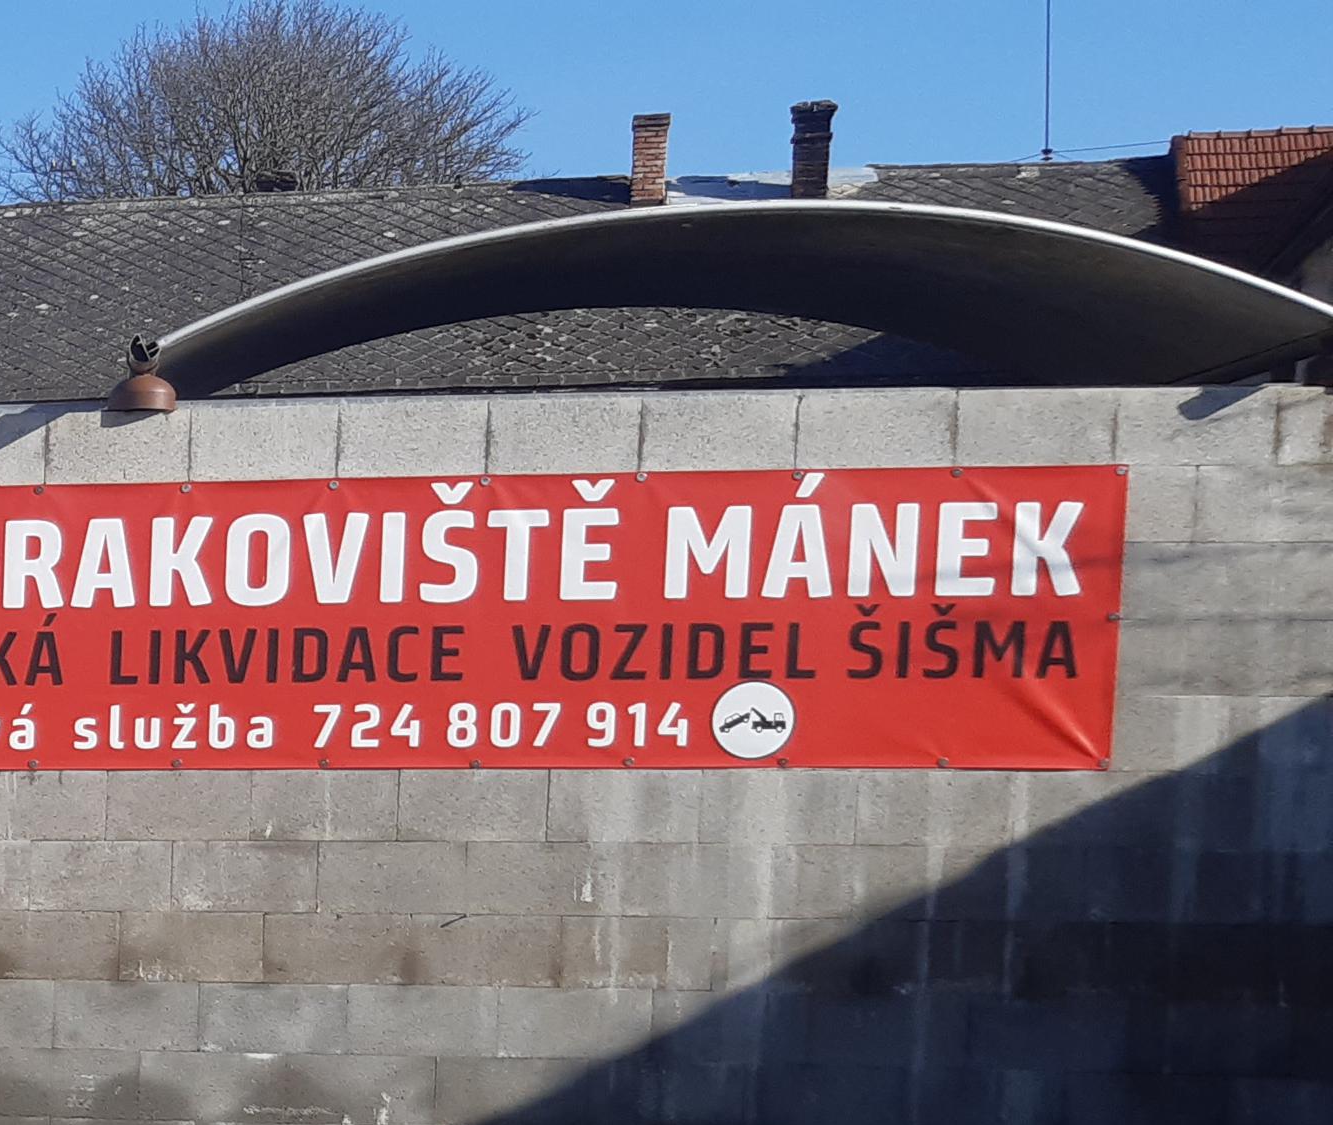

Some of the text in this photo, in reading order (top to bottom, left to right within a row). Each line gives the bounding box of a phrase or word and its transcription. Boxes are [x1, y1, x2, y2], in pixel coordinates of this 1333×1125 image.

[663, 472, 1085, 600] MÁNEK
[109, 624, 465, 686] LIKVIDACE
[511, 621, 818, 682] VOZIDEL
[845, 603, 1078, 680] ŠIŠMA
[73, 702, 275, 750] služba
[312, 703, 423, 749] 724
[446, 702, 563, 748] 807
[585, 702, 691, 747] 914
